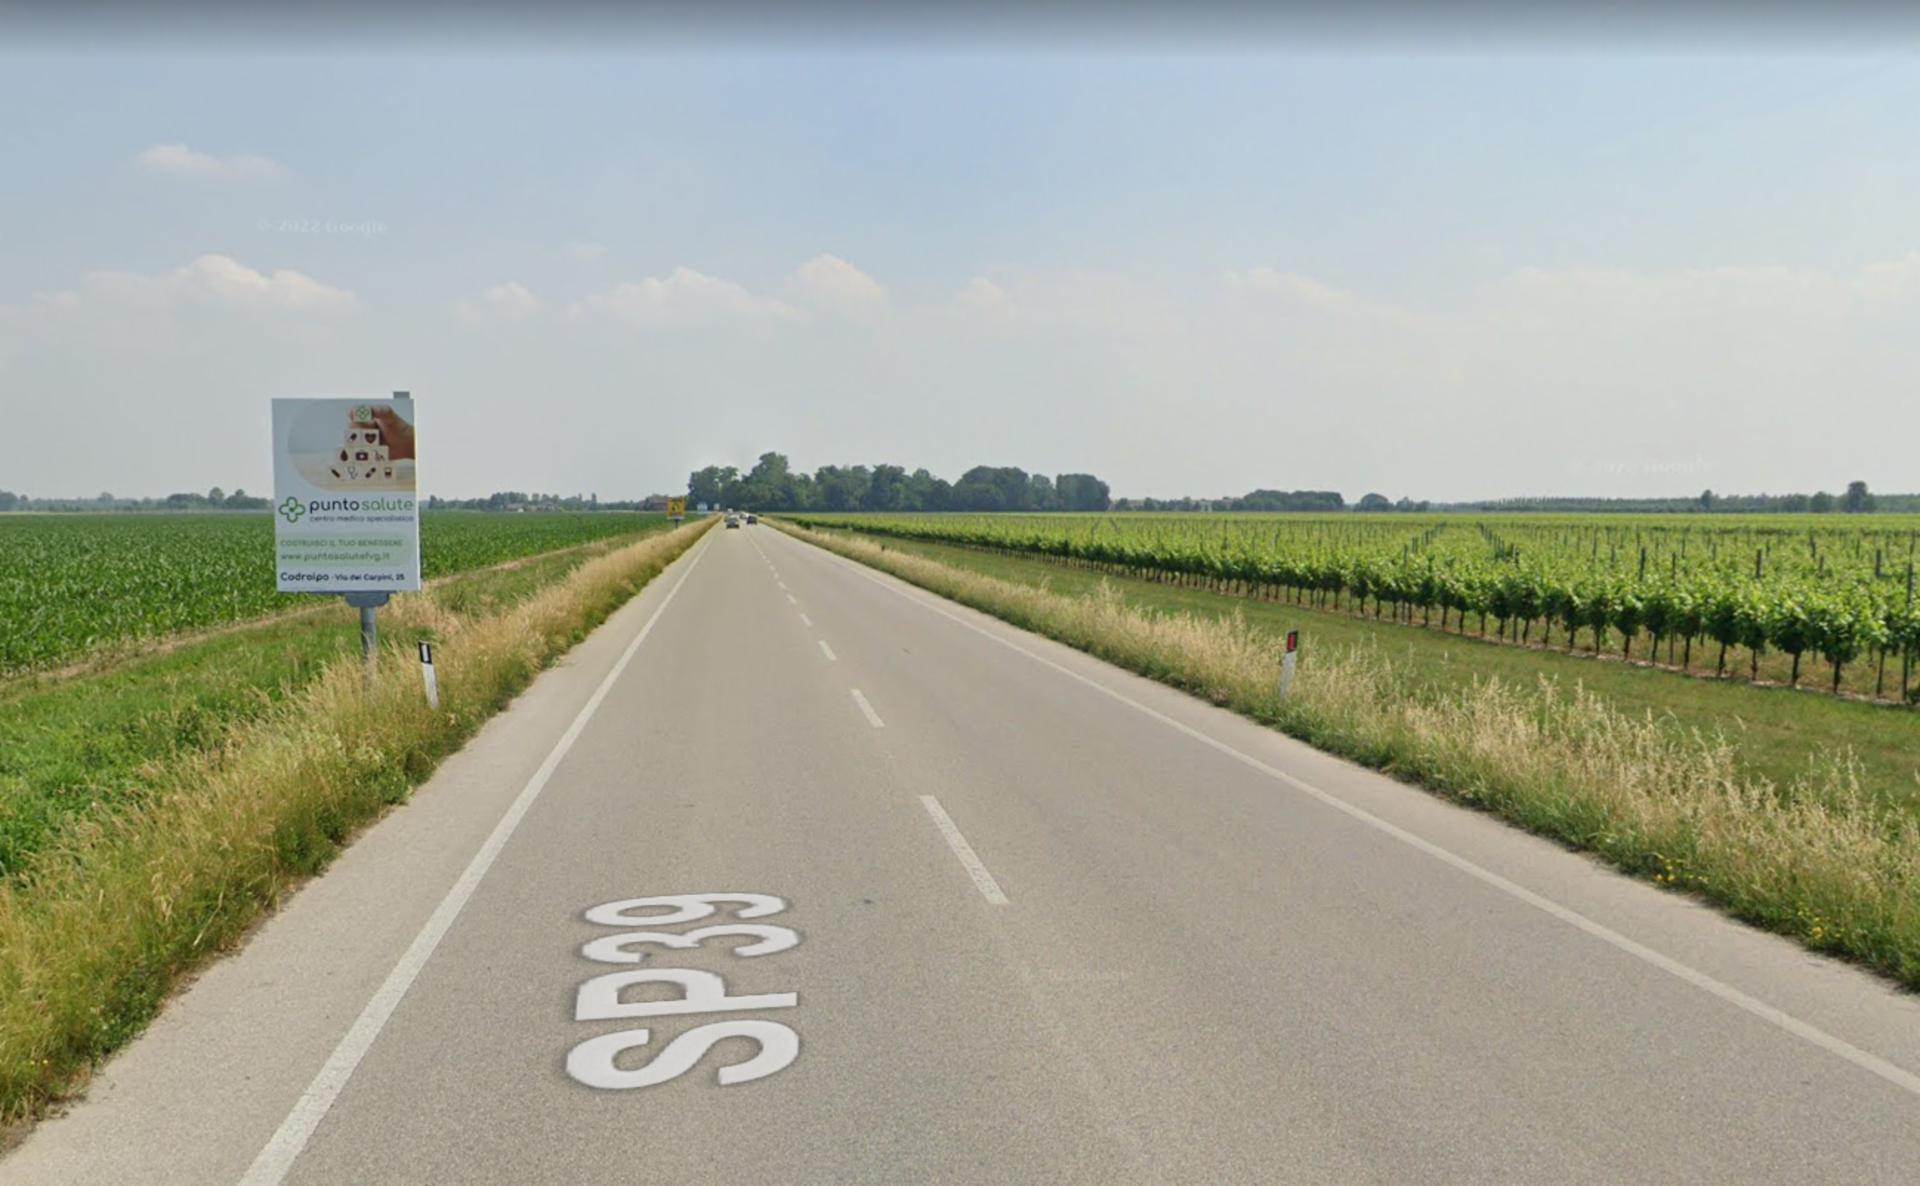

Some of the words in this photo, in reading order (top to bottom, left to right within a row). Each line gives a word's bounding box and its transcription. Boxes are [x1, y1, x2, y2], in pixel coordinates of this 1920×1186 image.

[366, 515, 414, 524] specialistico
[338, 539, 356, 547] TUO
[358, 539, 404, 547] BENESSERE
[280, 572, 329, 582] Codroipo
[334, 573, 348, 581] Via
